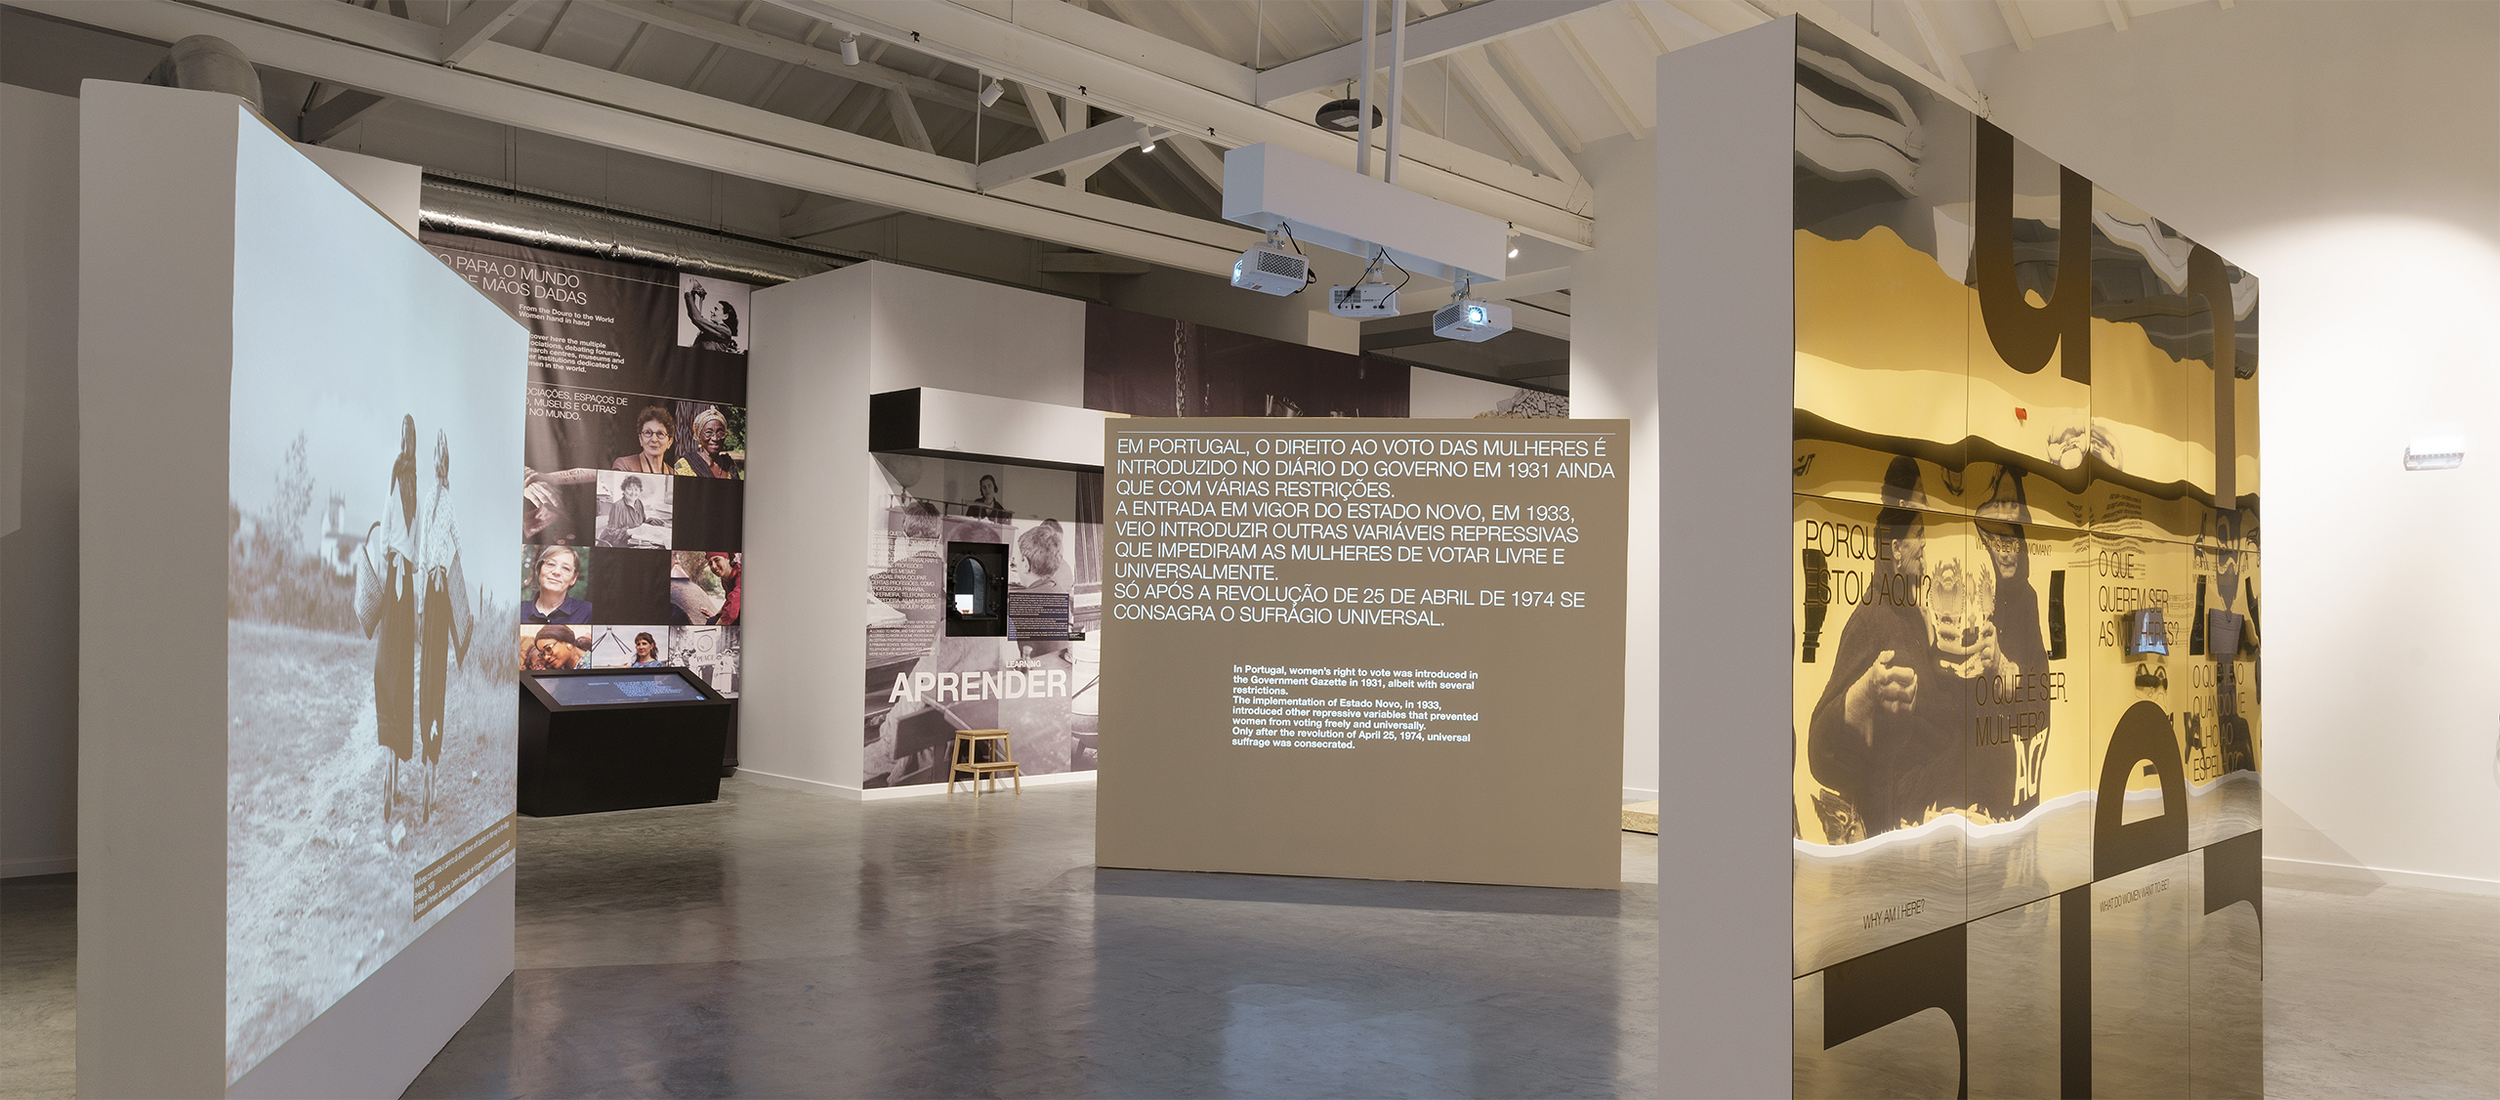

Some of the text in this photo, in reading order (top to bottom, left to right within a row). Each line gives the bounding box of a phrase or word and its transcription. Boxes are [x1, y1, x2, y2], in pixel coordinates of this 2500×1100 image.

[457, 256, 500, 275] PARA
[503, 264, 517, 278] O
[520, 267, 580, 288] MUNDO
[483, 276, 530, 296] MÃOS
[535, 286, 587, 305] DADAS
[519, 304, 614, 323] From Douro World
[519, 311, 545, 320] Women
[546, 315, 564, 323] hand
[530, 340, 621, 357] ociations, debating forums,
[550, 335, 566, 343] here
[580, 340, 606, 349] multiple
[529, 347, 611, 363] earch centres, museums
[538, 355, 610, 369] institutions dedicated
[566, 364, 587, 372] world.
[534, 398, 572, 410] MUSEUS
[574, 402, 580, 410] E
[581, 403, 617, 415] OUTRAS
[574, 392, 615, 405] ESPAÇOS
[616, 397, 628, 406] DE
[529, 408, 581, 420] NO MUNDO.
[1118, 438, 1606, 456] EM PORTUGAL, O DIREITO VOTO DAS MULHERES É
[1118, 459, 1615, 478] INTRODUZIDO DIÁRIO DO GOVERNO EM 1931 AINDA
[1117, 479, 1394, 500] QUE COM VÁRIAS RESTRIÇÕES.
[1116, 501, 1574, 523] A ENTRADA VIGOR ESTADO NOVO, 1933,
[1116, 521, 1578, 543] VEIO INTRODUZIR OUTRAS VARIÁVEIS REPRESSIVAS
[1805, 519, 1891, 561] PORQUE
[1115, 542, 1564, 564] QUE IMPEDIRAM AS MULHERES DE VOTAR LIVRE E
[1115, 563, 1279, 581] UNIVERSALMENTE.
[2099, 550, 2108, 577] O
[2111, 551, 2134, 579] QUE
[1114, 582, 1585, 607] SÓ APÓS A REVOLUÇÃO 25 ABRIL 1974 SE
[1806, 569, 1931, 608] ESTOU AQUI?
[2099, 585, 2146, 612] QUEREM
[2149, 588, 2169, 613] SER
[1114, 604, 1444, 626] CONSAGRA O SUFRÁGIO UNIVERSAL.
[2099, 620, 2179, 647] AS MULHERES?
[1005, 660, 1041, 668] LEARNING
[1245, 665, 1467, 679] Portugal, women's right vote introduced
[1251, 676, 1474, 689] Government Gazette 1931, albeit with several
[2193, 664, 2200, 688] O
[888, 669, 1066, 703] APRENDER
[1233, 686, 1288, 696] restrictions.
[1976, 675, 1988, 706] O
[1992, 674, 2023, 705] QUE
[2027, 666, 2036, 702] É
[1253, 696, 1441, 711] implementation Estado Novo, 1933,
[1233, 706, 1478, 721] introduced other repressive variables that prevented
[1233, 718, 1426, 731] women from voting freely universally.
[1976, 710, 2046, 747] MULHER?
[1232, 726, 1470, 742] Only after revolution April 25, 1974, universal
[1232, 738, 1355, 749] suffrage consecrated.
[1863, 898, 1926, 929] WHY AM HERE?
